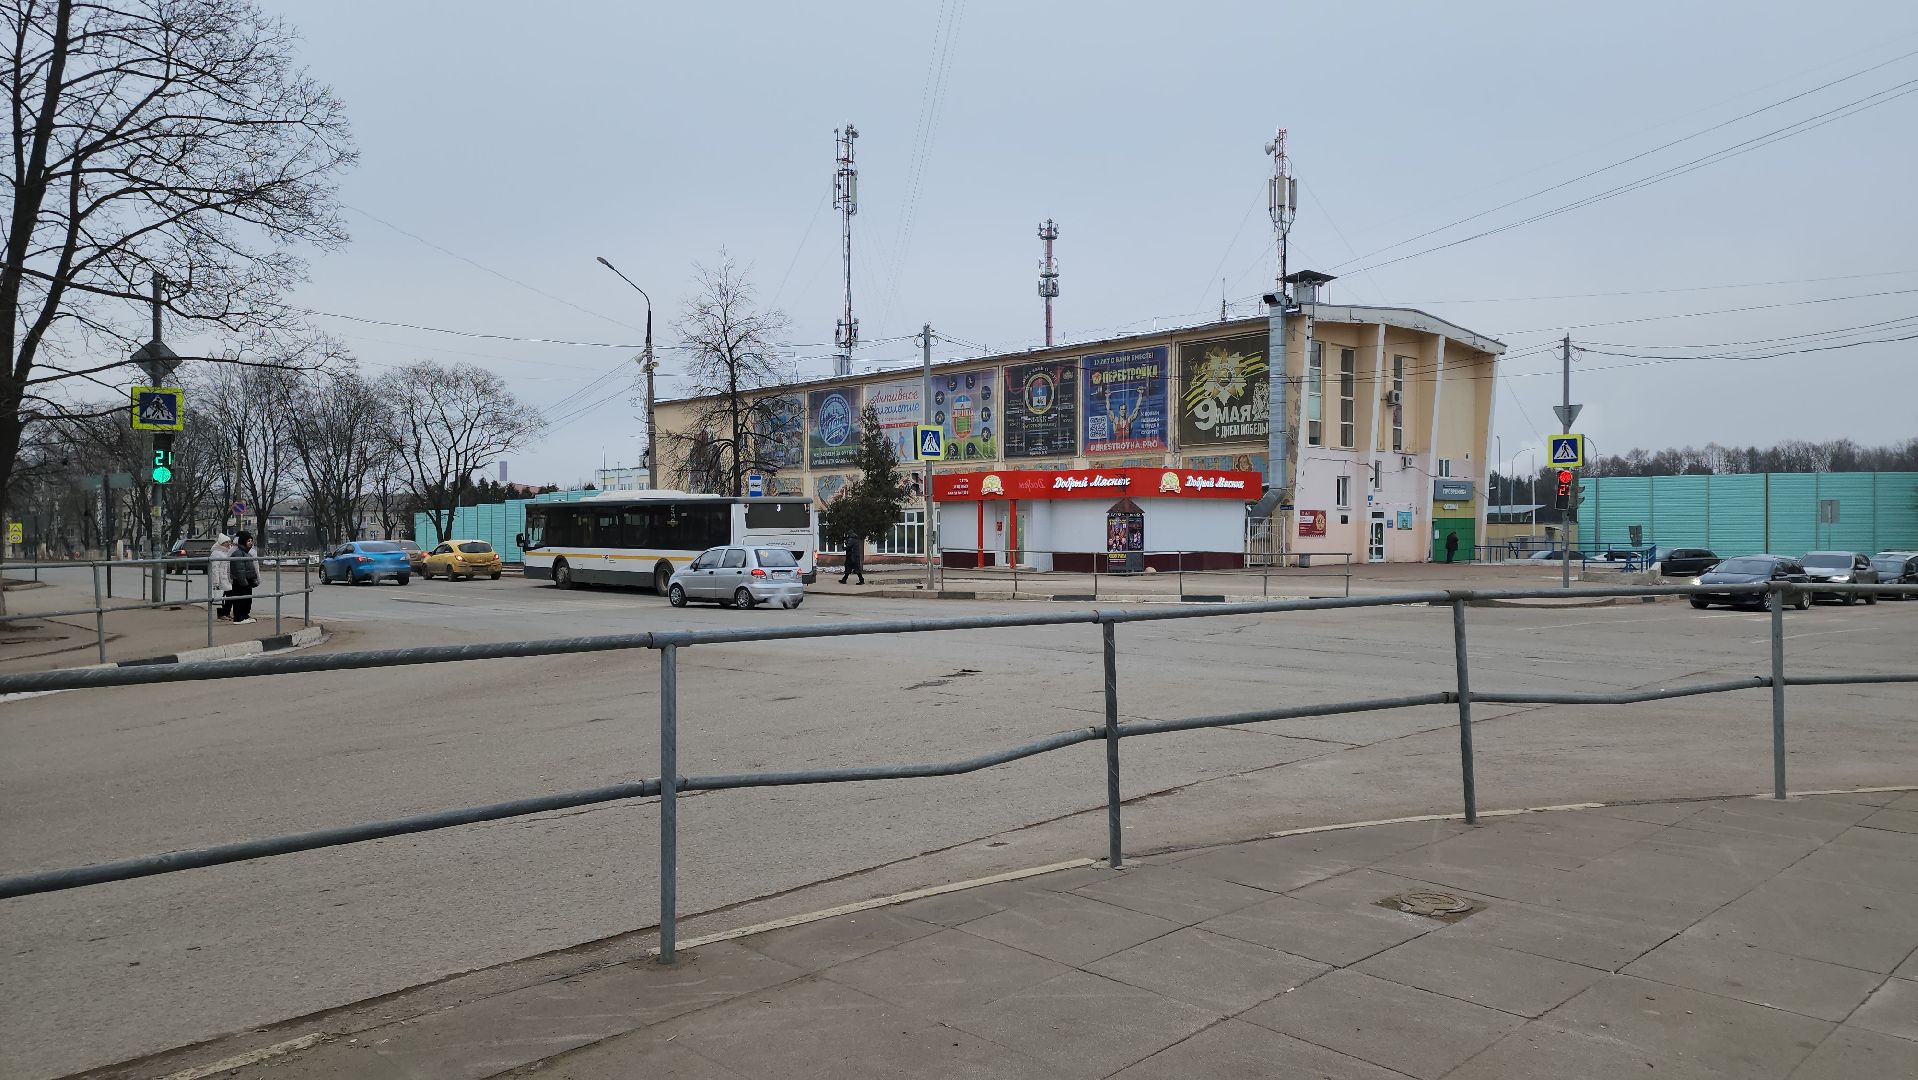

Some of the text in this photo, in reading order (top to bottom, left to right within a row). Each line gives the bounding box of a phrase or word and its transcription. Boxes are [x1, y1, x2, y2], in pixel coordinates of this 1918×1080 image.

[1102, 363, 1158, 383] ПЕРЕСТРОЙКА
[1194, 398, 1217, 430] 9
[1215, 405, 1252, 424] МАЯ
[1216, 426, 1220, 437] С
[1221, 425, 1240, 438] ДНЕМ
[155, 451, 172, 465] 21
[1053, 475, 1131, 491] Добрый Мясник
[1185, 476, 1245, 490] Добрый Мясник
[776, 504, 781, 512] 3
